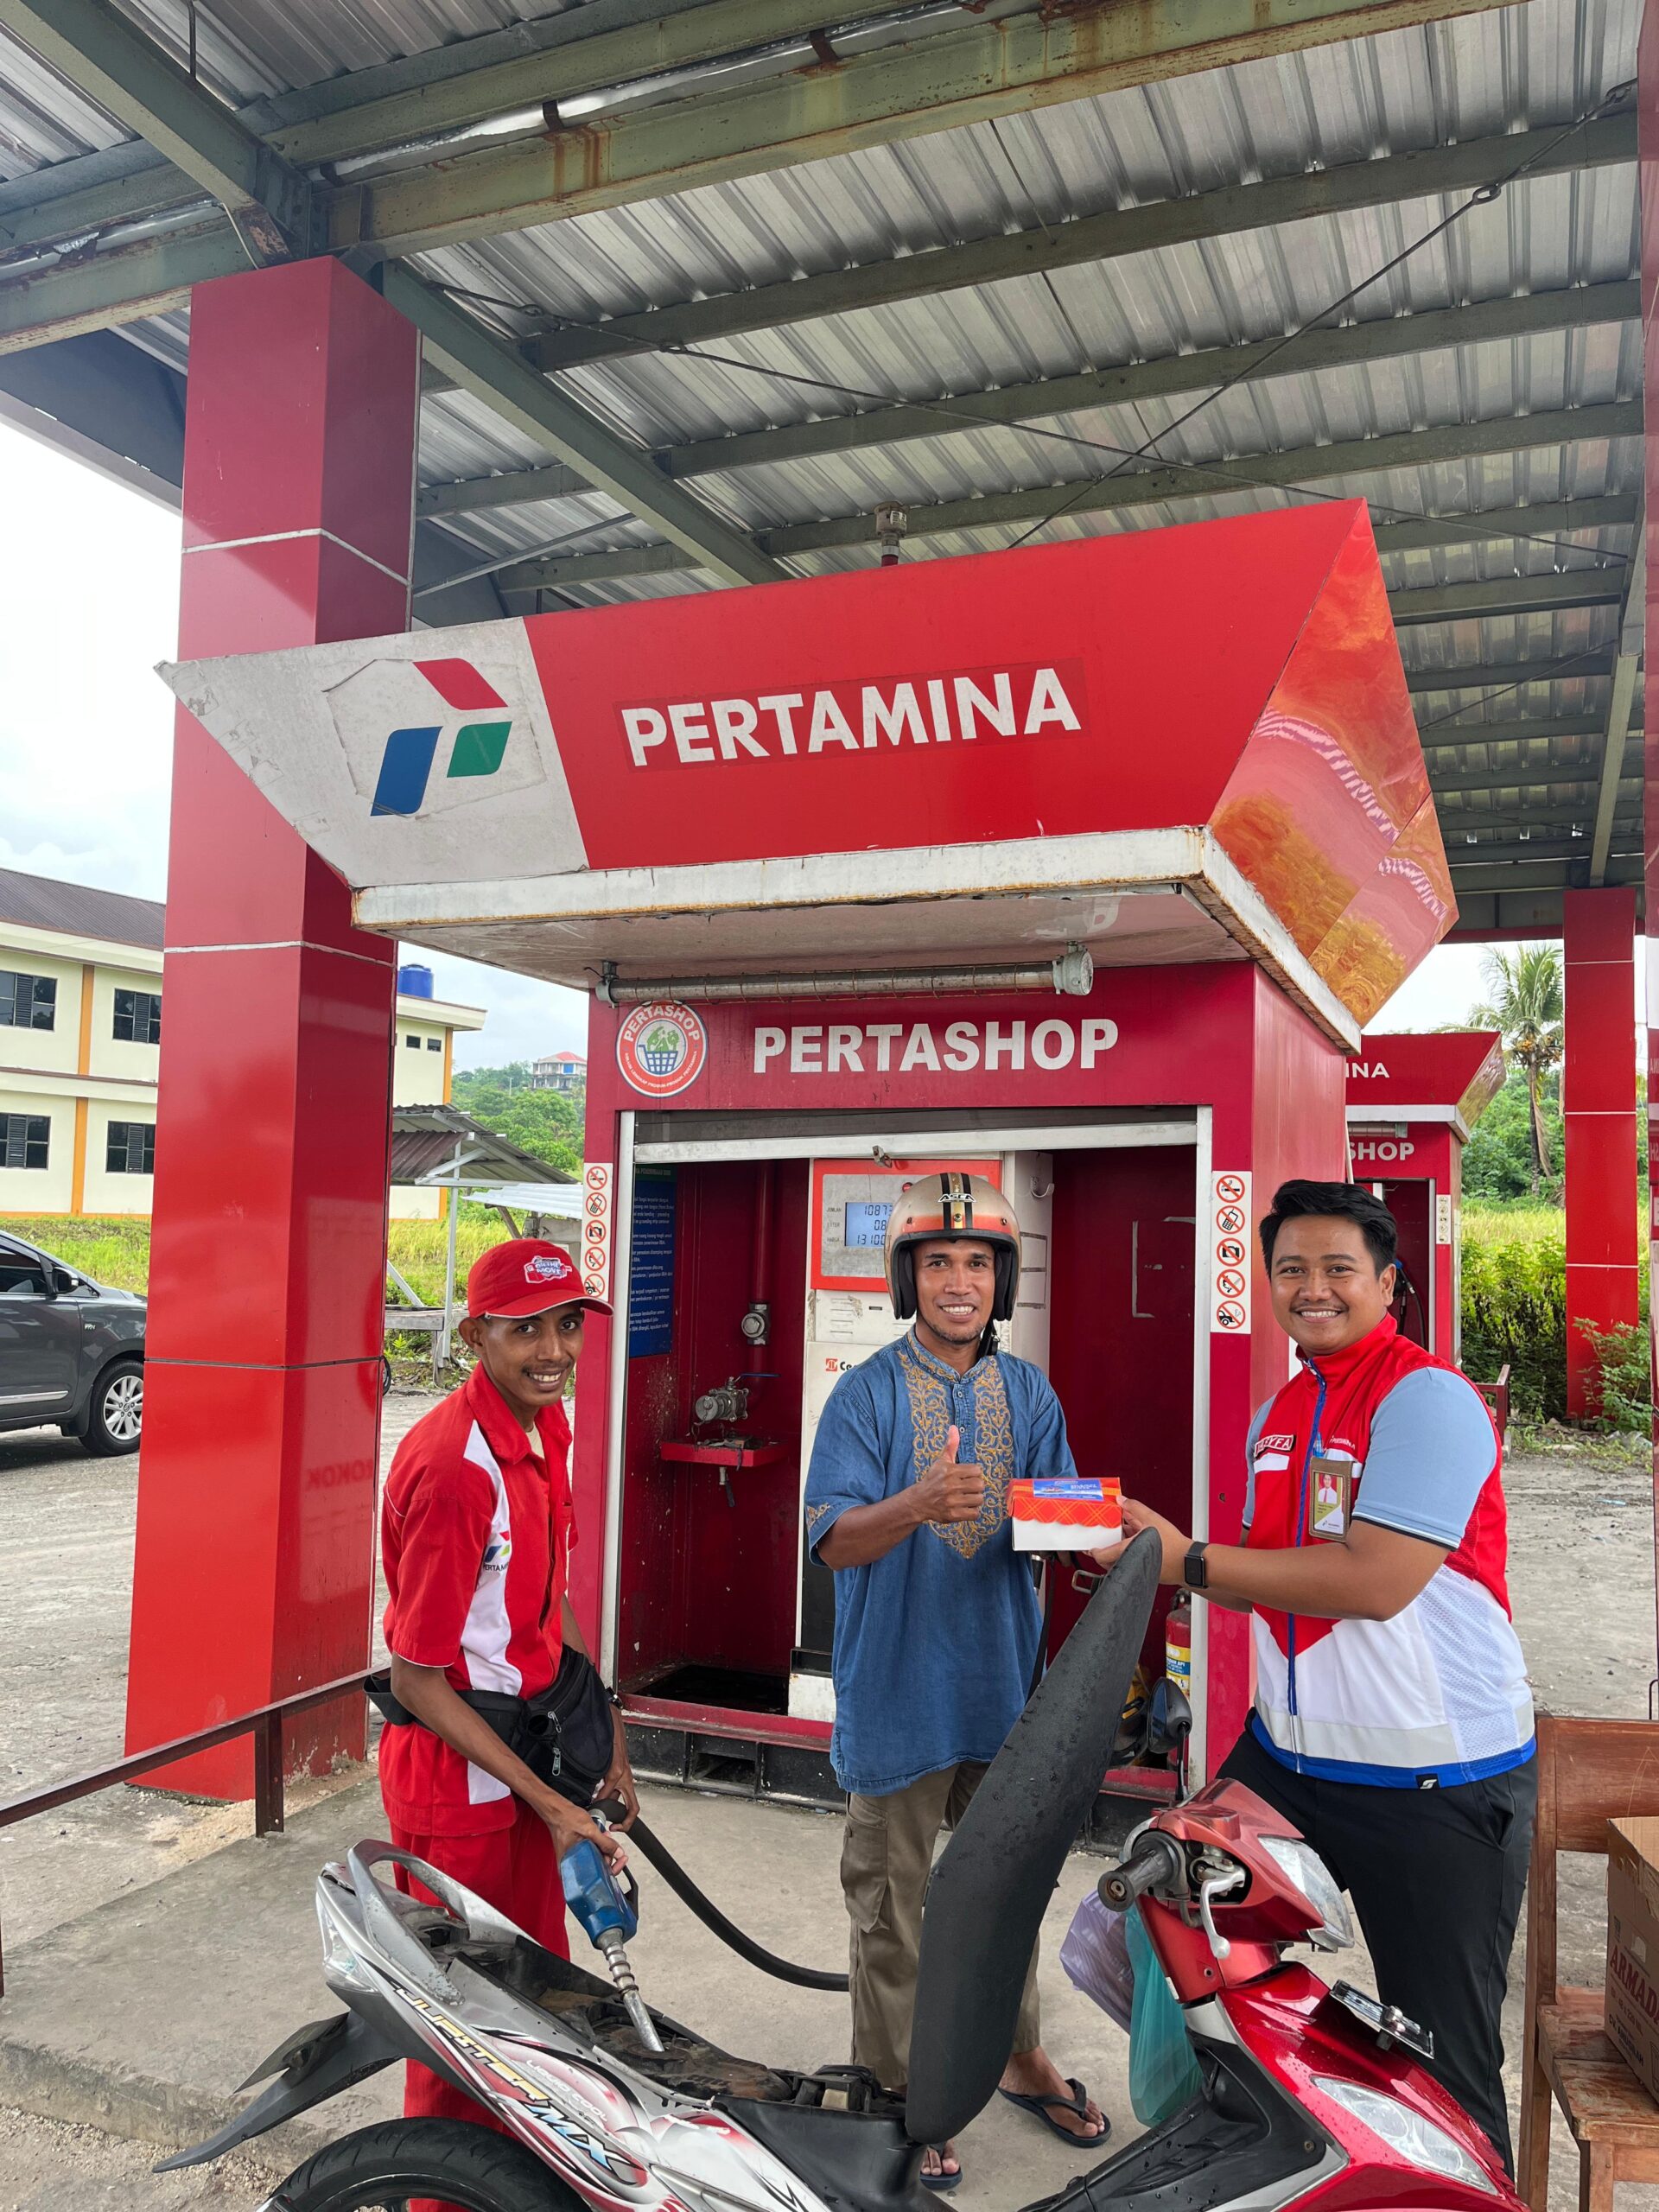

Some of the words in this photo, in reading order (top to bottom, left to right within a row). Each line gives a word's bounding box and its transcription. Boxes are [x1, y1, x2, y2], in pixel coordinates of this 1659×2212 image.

[620, 667, 1082, 767] PERTAMINA
[623, 1005, 701, 1042] PERTASHOP
[753, 1019, 1119, 1073] PERTASHOP
[393, 1986, 552, 2101] JUPITER
[519, 2100, 648, 2179] MX
[568, 2091, 608, 2121] COOL
